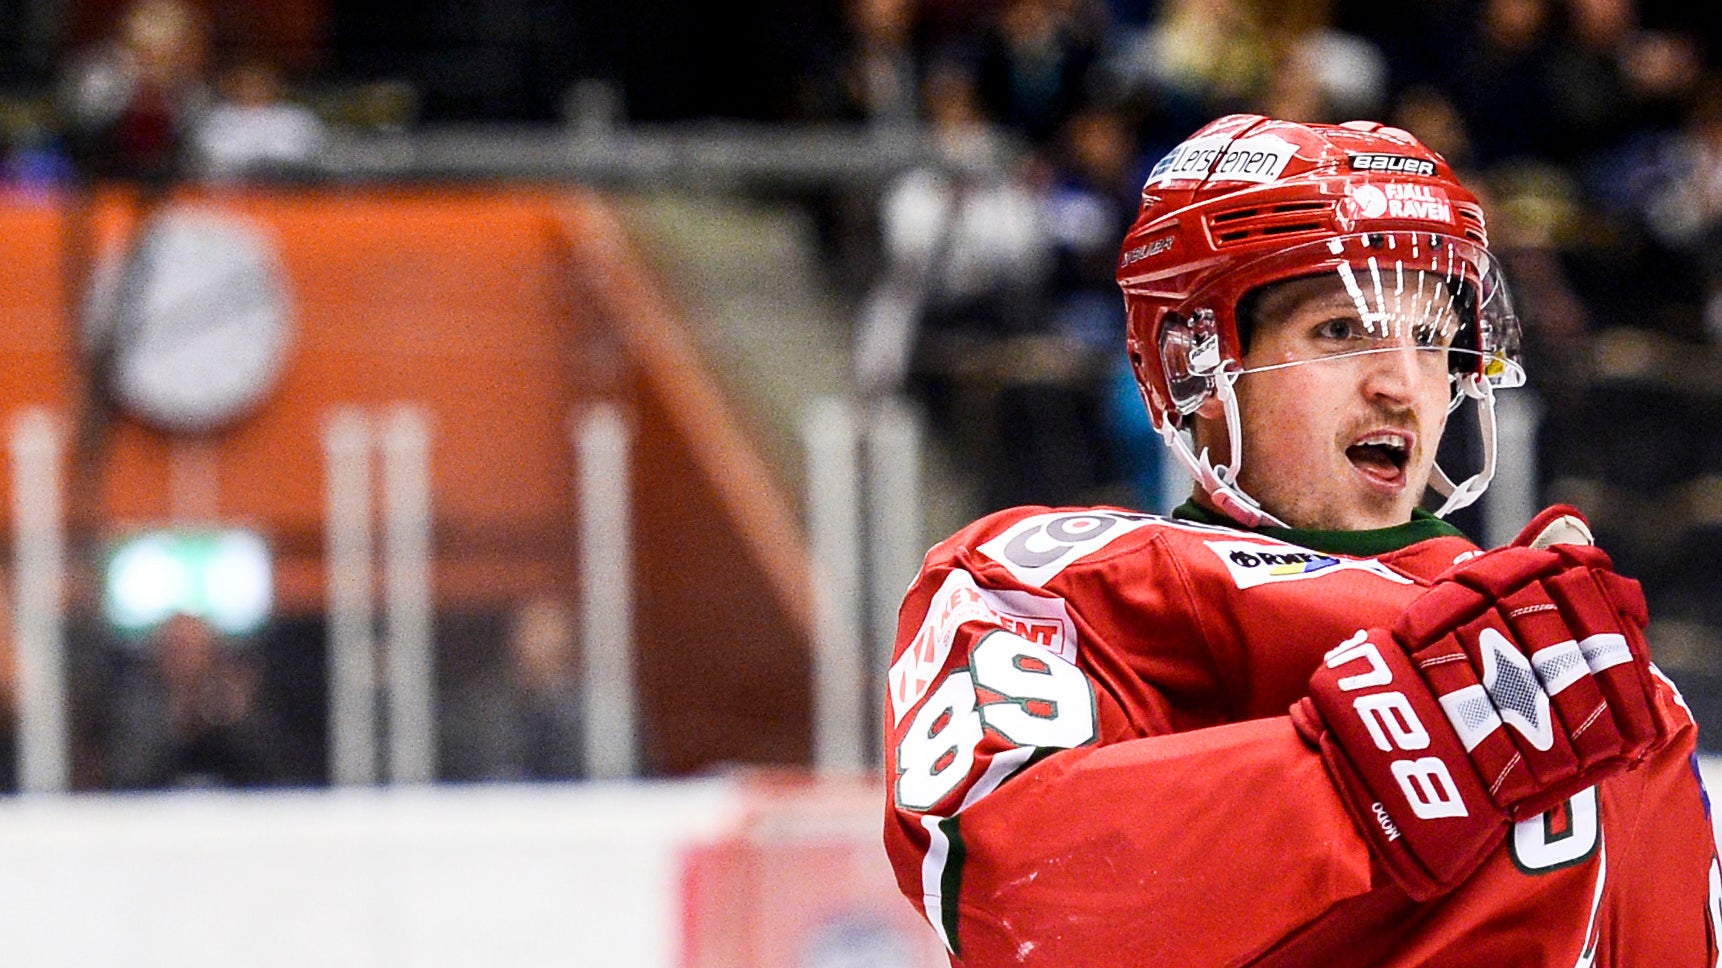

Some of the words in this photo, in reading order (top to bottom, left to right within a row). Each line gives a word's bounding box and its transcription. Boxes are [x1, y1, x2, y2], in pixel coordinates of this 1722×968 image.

[1353, 155, 1434, 176] BAUER
[896, 628, 1099, 812] 89
[1324, 629, 1469, 820] BAU
